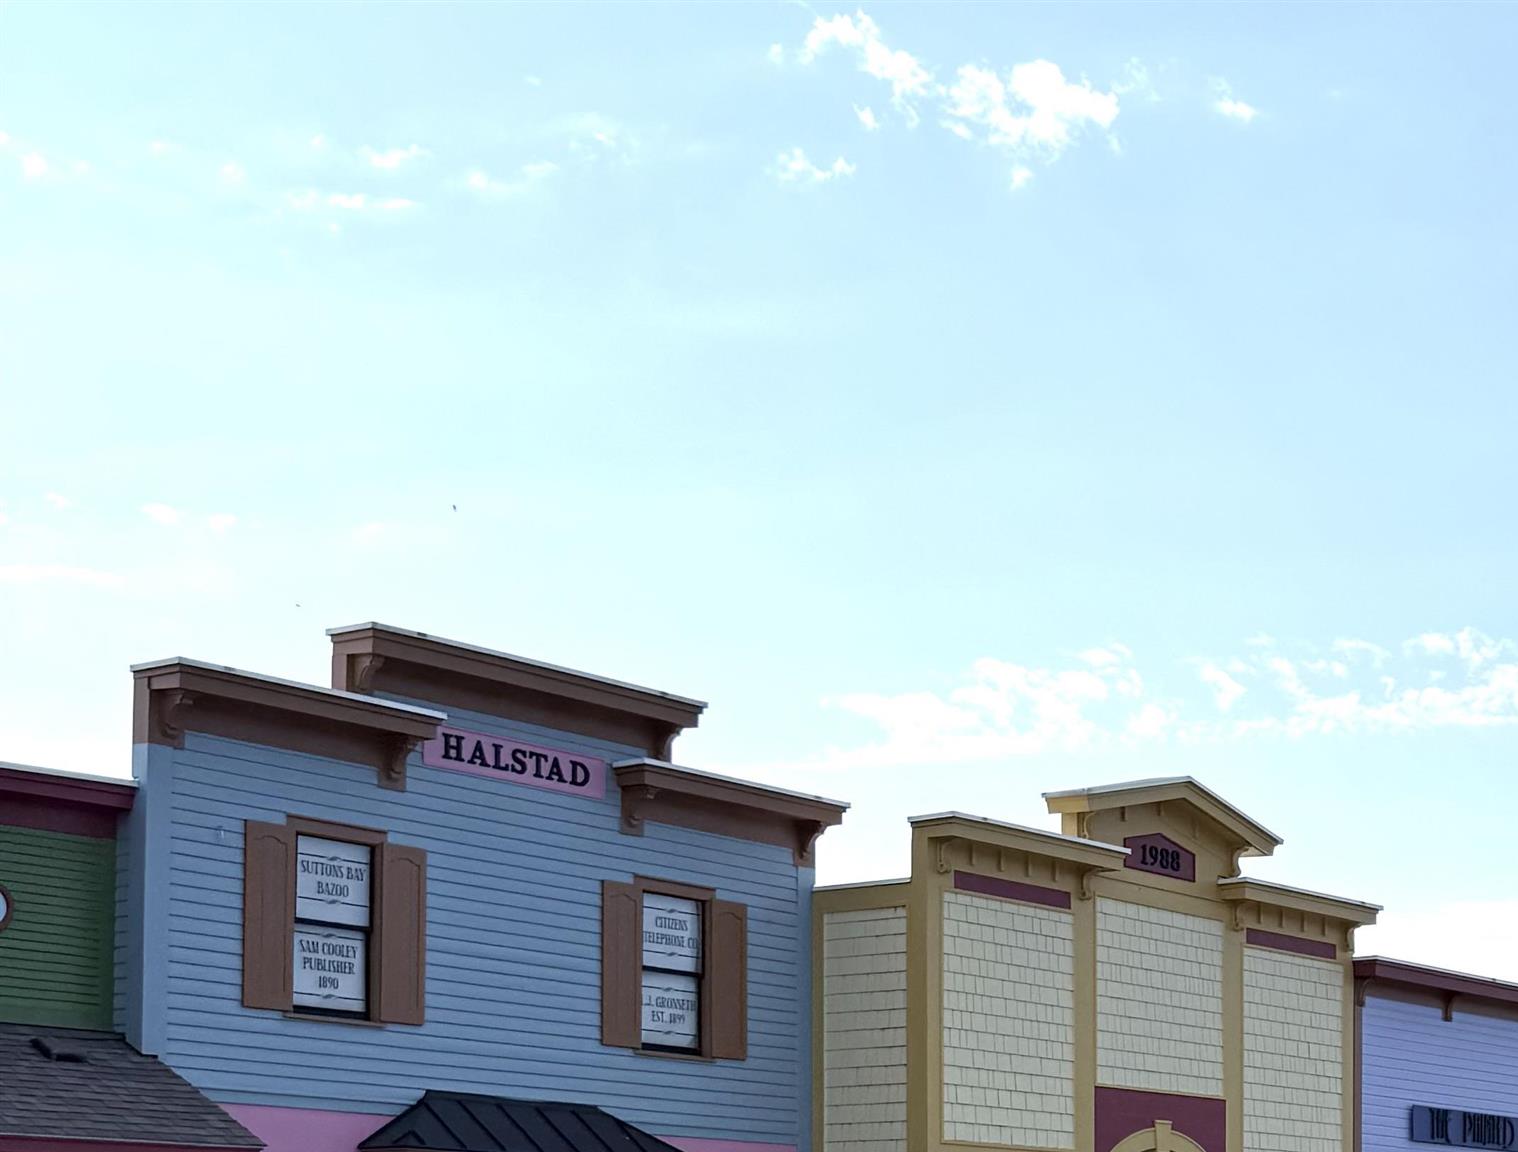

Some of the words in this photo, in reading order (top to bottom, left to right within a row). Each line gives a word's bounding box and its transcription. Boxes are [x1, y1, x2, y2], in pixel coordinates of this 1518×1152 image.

[441, 732, 591, 787] HALSTAD
[1140, 844, 1181, 872] 1988
[301, 859, 344, 878] SUTTONS
[346, 867, 367, 882] BAY
[317, 881, 350, 898] BAZOO
[655, 916, 689, 932] CITIZENS
[642, 931, 686, 948] TELEPHONE
[299, 939, 320, 954] SAM
[322, 942, 358, 960] COOLEY
[302, 956, 356, 975] PUBLISHER
[318, 975, 339, 990] 1890
